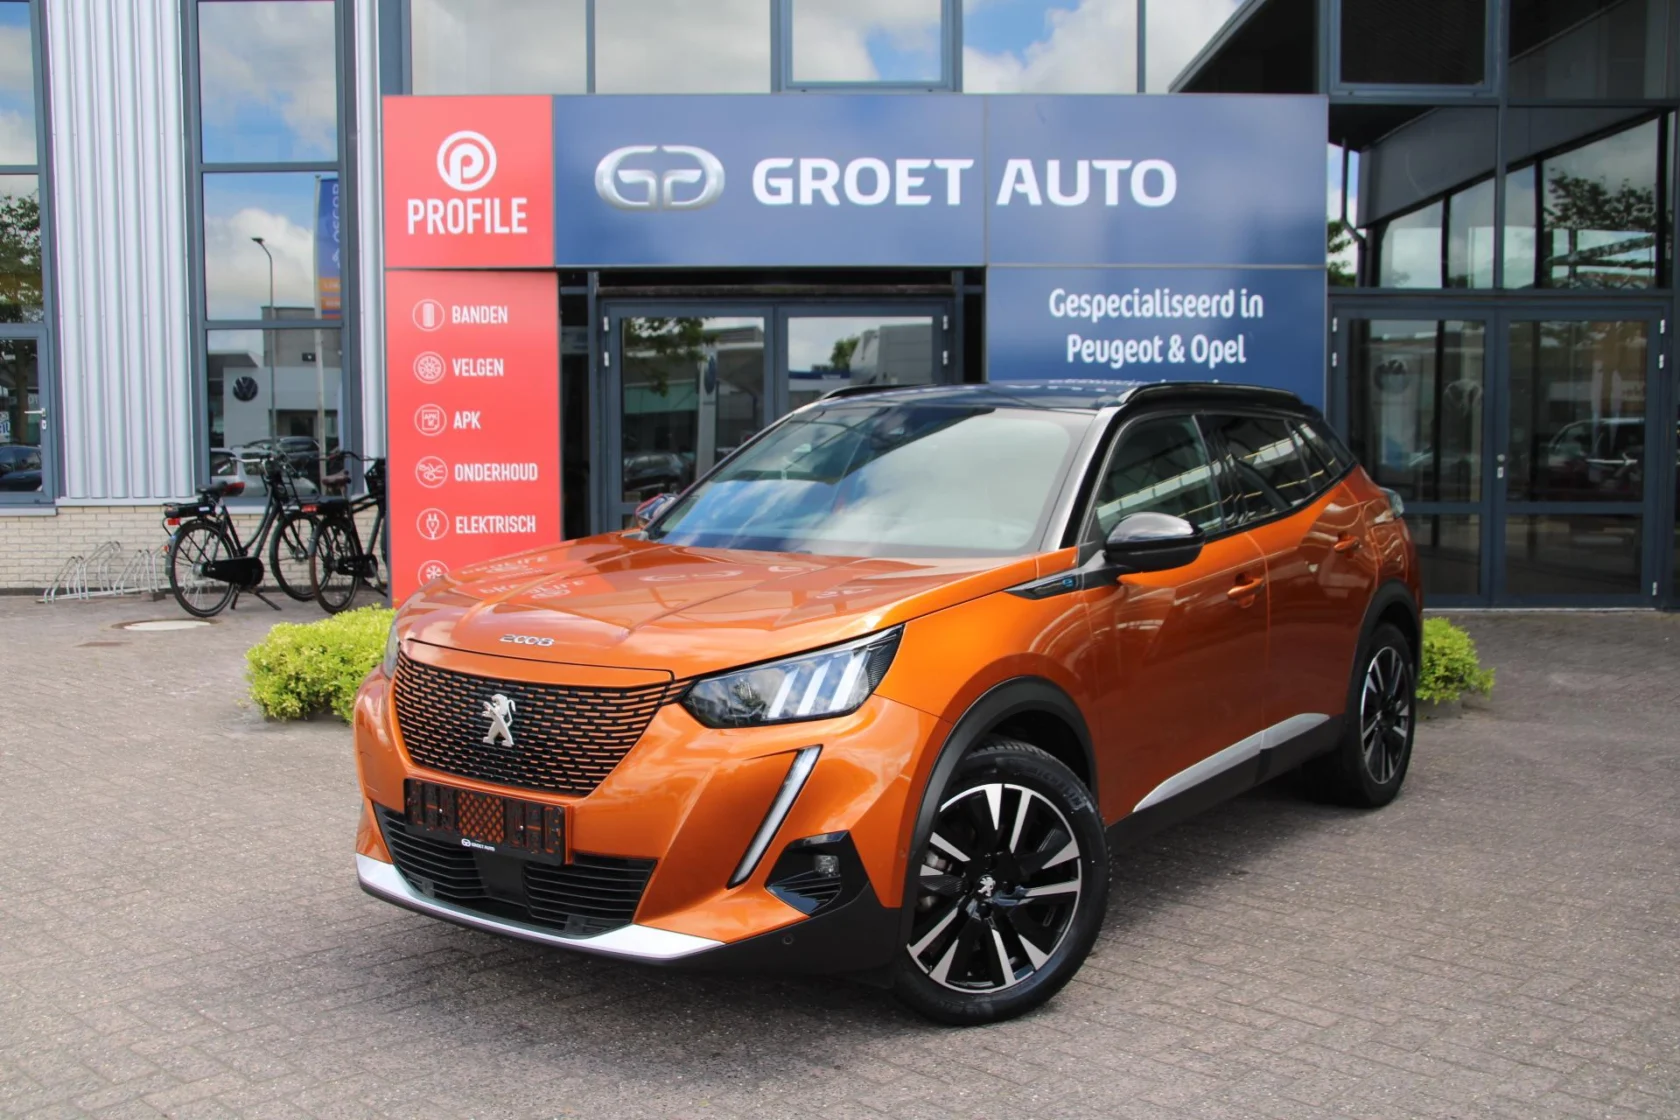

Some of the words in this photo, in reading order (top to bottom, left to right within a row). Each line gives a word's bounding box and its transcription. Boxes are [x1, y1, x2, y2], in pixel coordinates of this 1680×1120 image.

[752, 157, 974, 206] GROET
[997, 159, 1178, 207] AUTO
[407, 198, 528, 235] PROFILE
[451, 305, 509, 324] BANDEN
[1049, 287, 1235, 323] Gespecialiseerd
[1240, 288, 1264, 318] in
[1067, 333, 1163, 369] Peugeot
[1167, 333, 1186, 364] &
[1190, 333, 1247, 369] Opel
[452, 358, 505, 377] VELGEN
[453, 411, 482, 430] APK
[454, 463, 539, 481] ONDERHOUD
[455, 515, 537, 534] ELEKTRISCH
[499, 633, 555, 648] 2008
